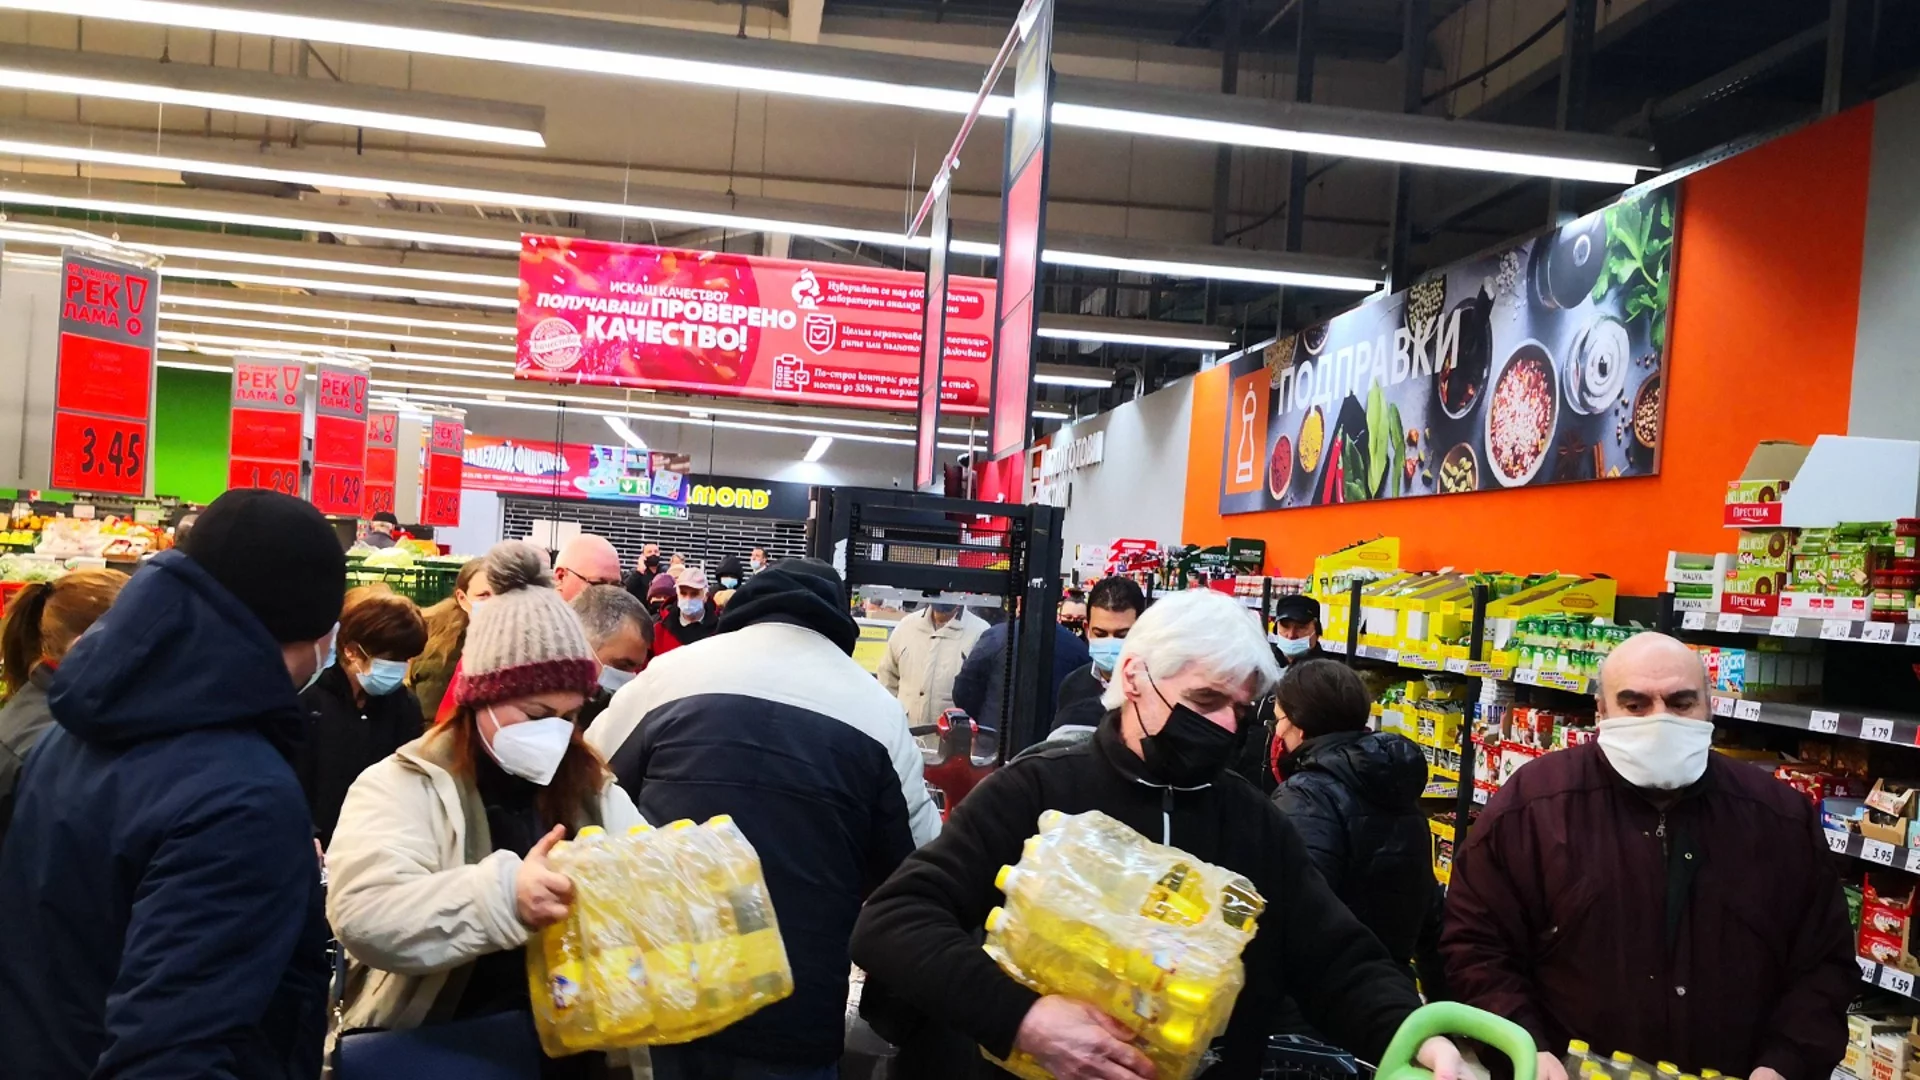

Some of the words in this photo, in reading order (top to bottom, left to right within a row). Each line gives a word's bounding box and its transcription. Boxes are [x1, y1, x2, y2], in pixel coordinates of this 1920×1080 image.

[66, 274, 120, 310] РЕК
[610, 281, 657, 297] ИСКАШ
[658, 286, 729, 303] КАЧЕСТВО?
[63, 301, 120, 329] ЛАМА
[536, 292, 649, 317] ПОЛУЧАВАШ
[651, 297, 797, 330] ПРОВЕРЕНО
[586, 314, 748, 353] КАЧЕСТВО!
[873, 330, 922, 341] ограничава
[1278, 308, 1462, 417] ПОДПРАВКИ
[237, 371, 278, 390] РЕК
[321, 378, 351, 397] РЕК
[82, 427, 140, 477] 3.45
[686, 484, 769, 510] MOND
[1732, 507, 1769, 518] ПРЕСТИЖ
[1730, 595, 1766, 607] ПРЕСТИЖ
[1745, 708, 1760, 720] 1.79
[1822, 719, 1837, 730] 1.79
[1872, 726, 1889, 738] 1.79
[1873, 848, 1892, 862] 3.95
[1892, 977, 1910, 992] 1.59
